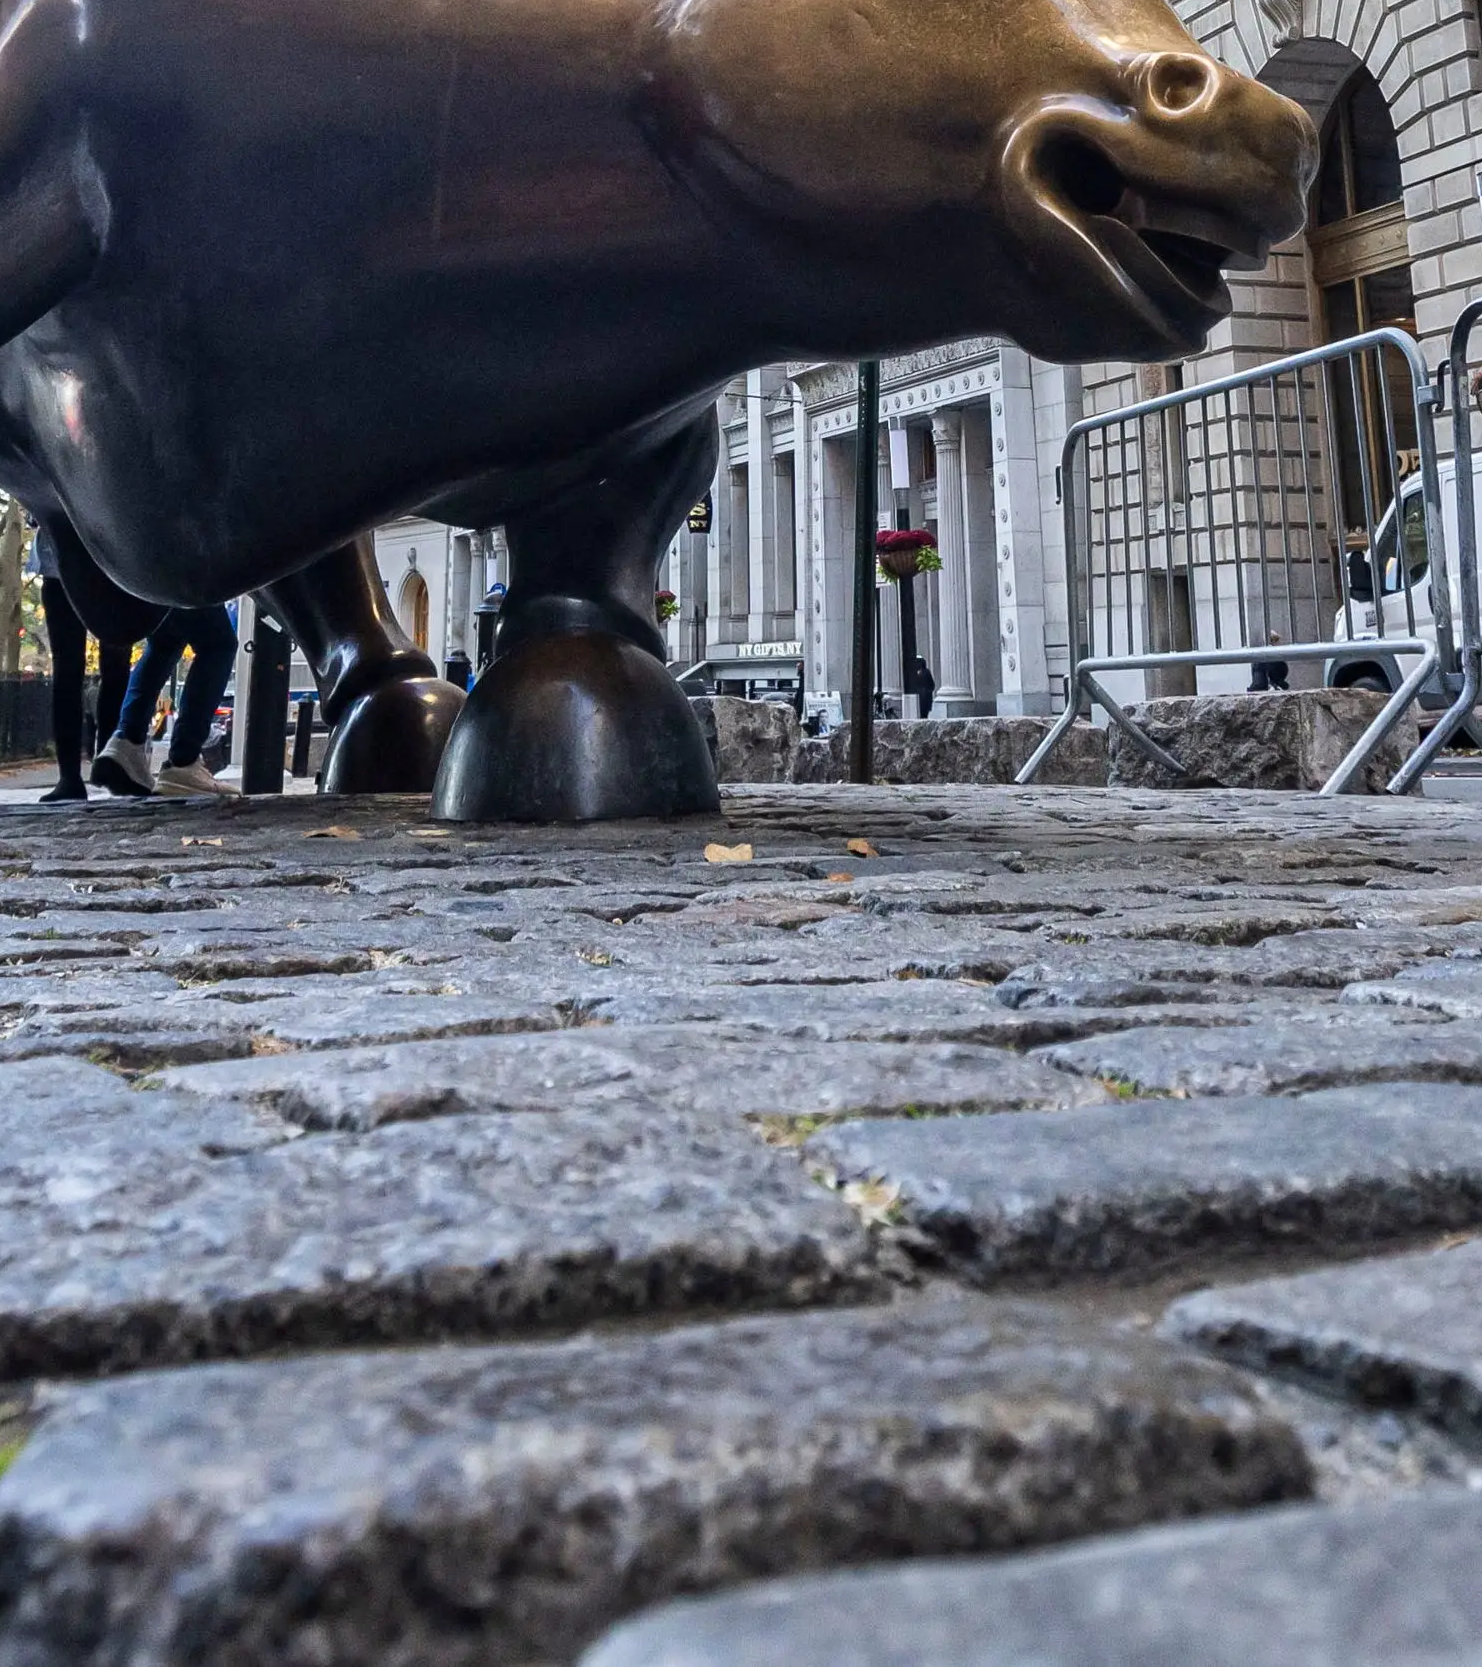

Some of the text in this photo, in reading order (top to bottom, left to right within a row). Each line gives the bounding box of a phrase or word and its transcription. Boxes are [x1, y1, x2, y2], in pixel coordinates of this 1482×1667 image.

[689, 519, 708, 528] NY
[738, 644, 753, 657] NY
[786, 642, 802, 655] NY
